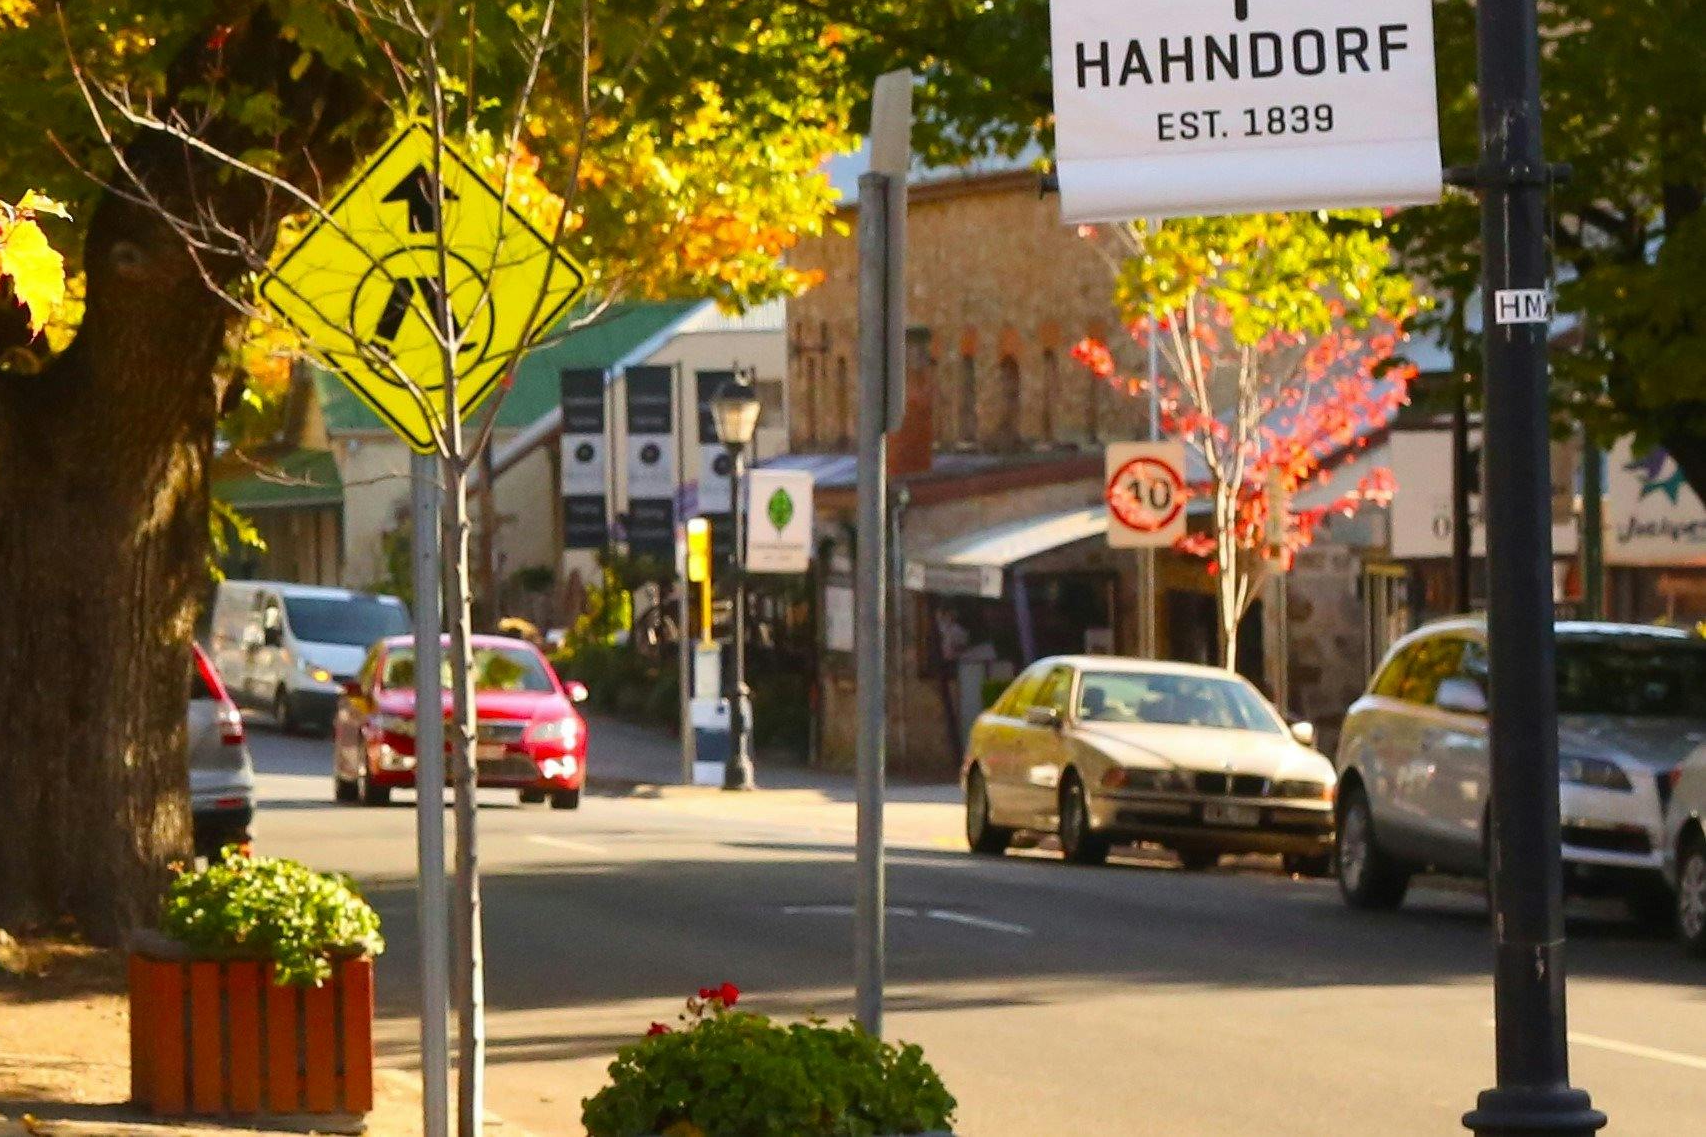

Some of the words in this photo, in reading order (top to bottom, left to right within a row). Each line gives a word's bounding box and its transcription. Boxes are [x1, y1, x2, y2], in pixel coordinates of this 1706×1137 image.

[1075, 23, 1408, 88] HAHNDORF
[1156, 109, 1228, 142] EST.
[1243, 103, 1334, 137] 1839
